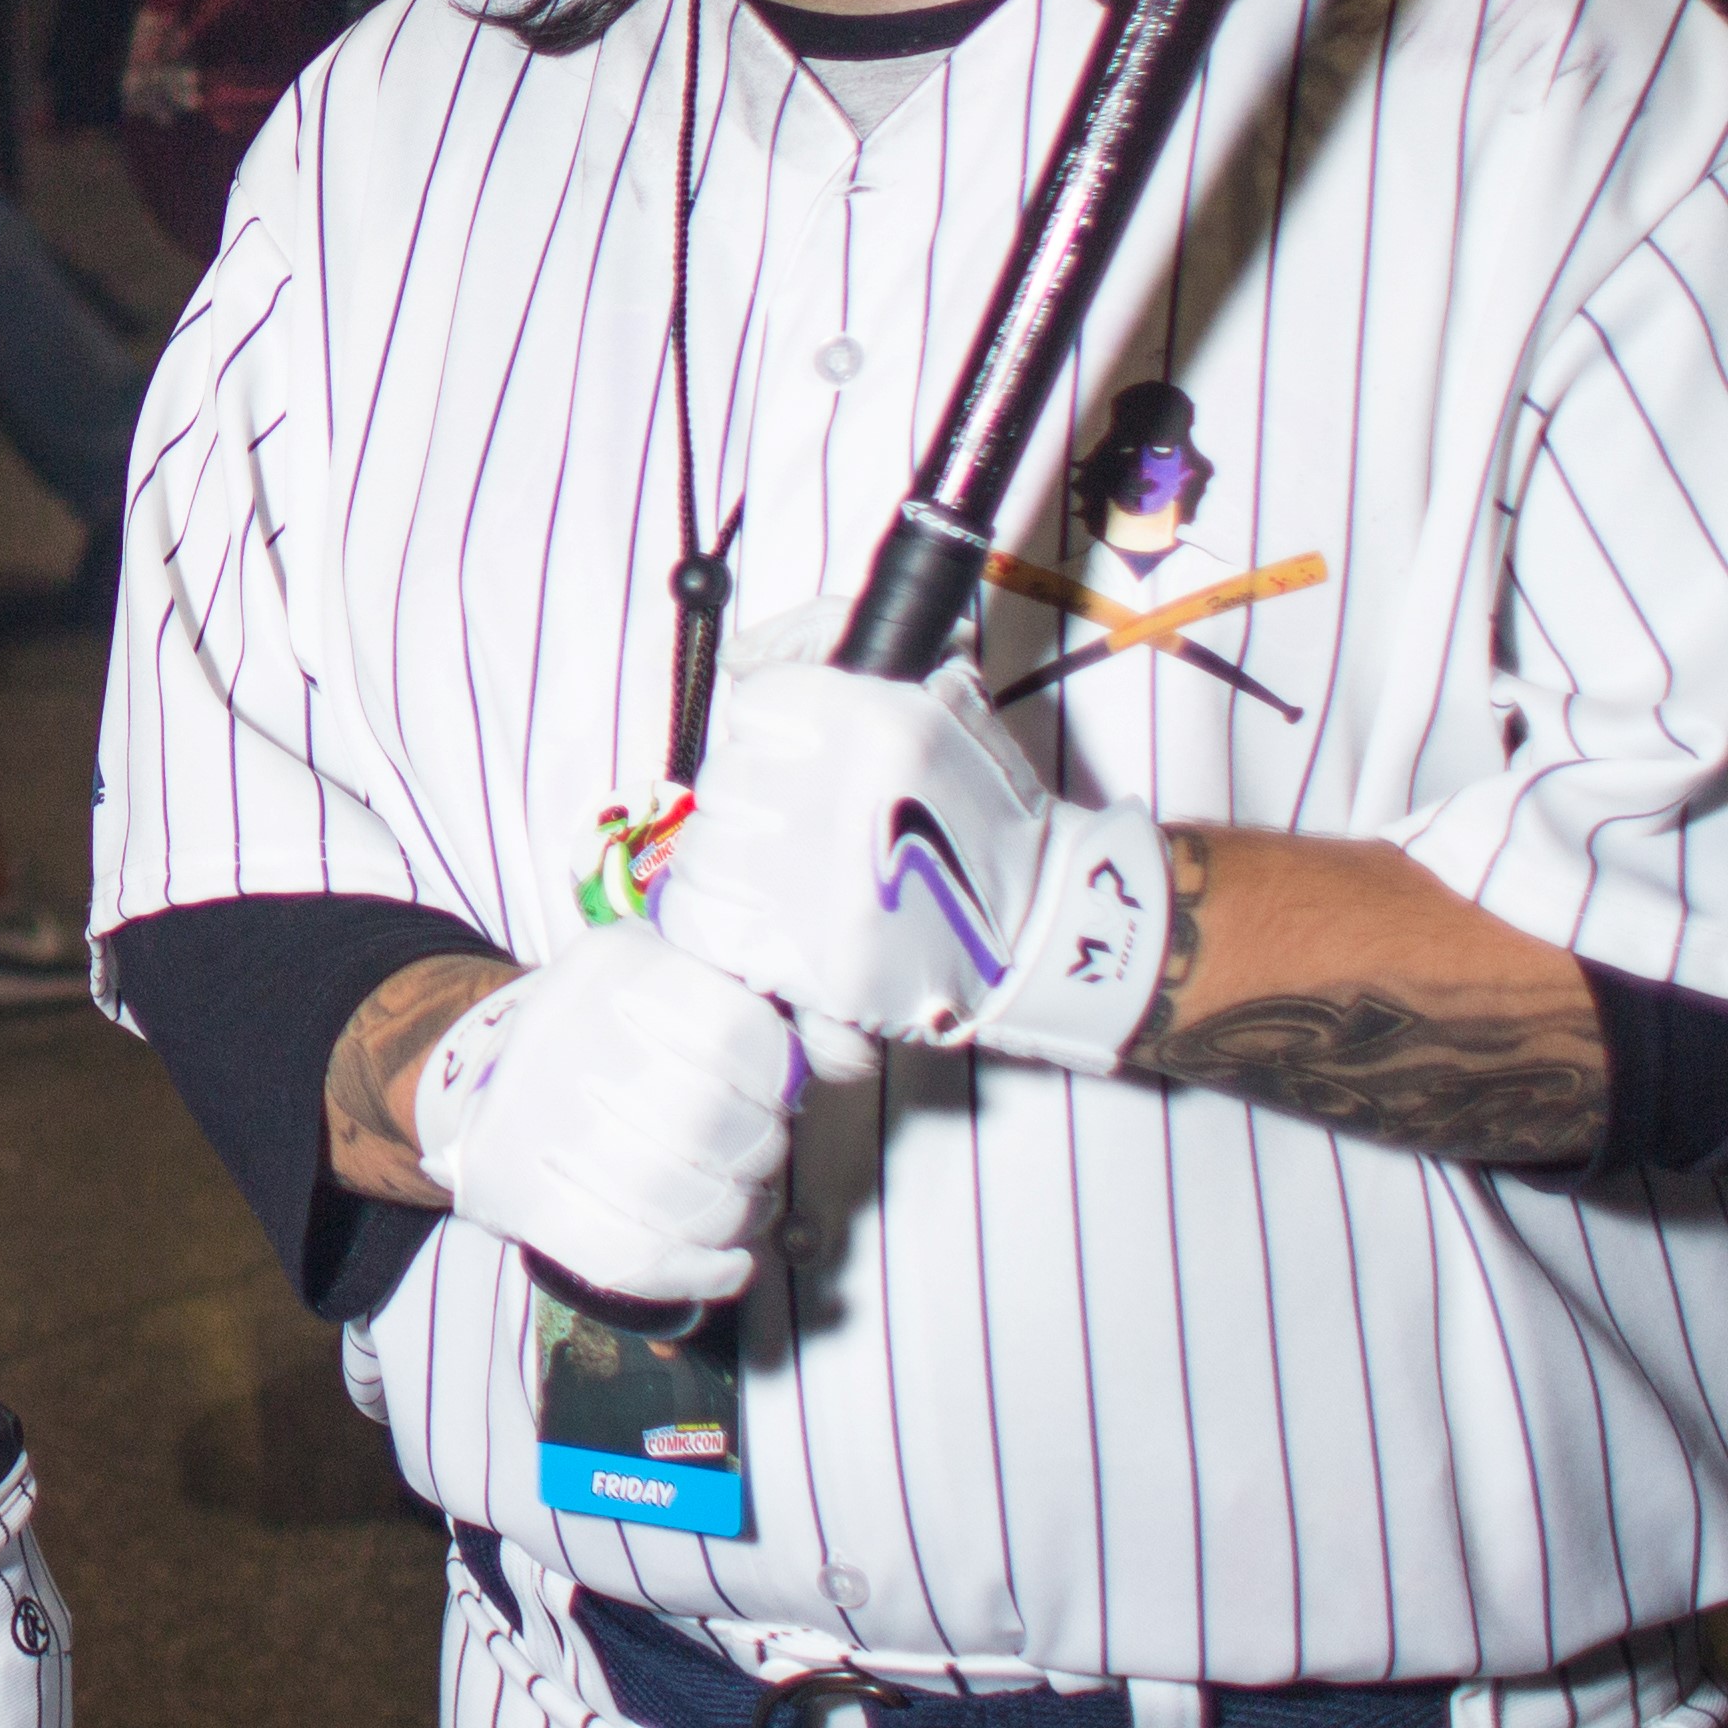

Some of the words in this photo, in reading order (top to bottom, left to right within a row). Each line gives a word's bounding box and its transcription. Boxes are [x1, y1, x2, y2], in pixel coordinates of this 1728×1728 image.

[915, 509, 991, 550] EASTO
[647, 1434, 690, 1454] COMIC
[693, 1432, 722, 1452] CON
[591, 1469, 676, 1509] FRIDAY
